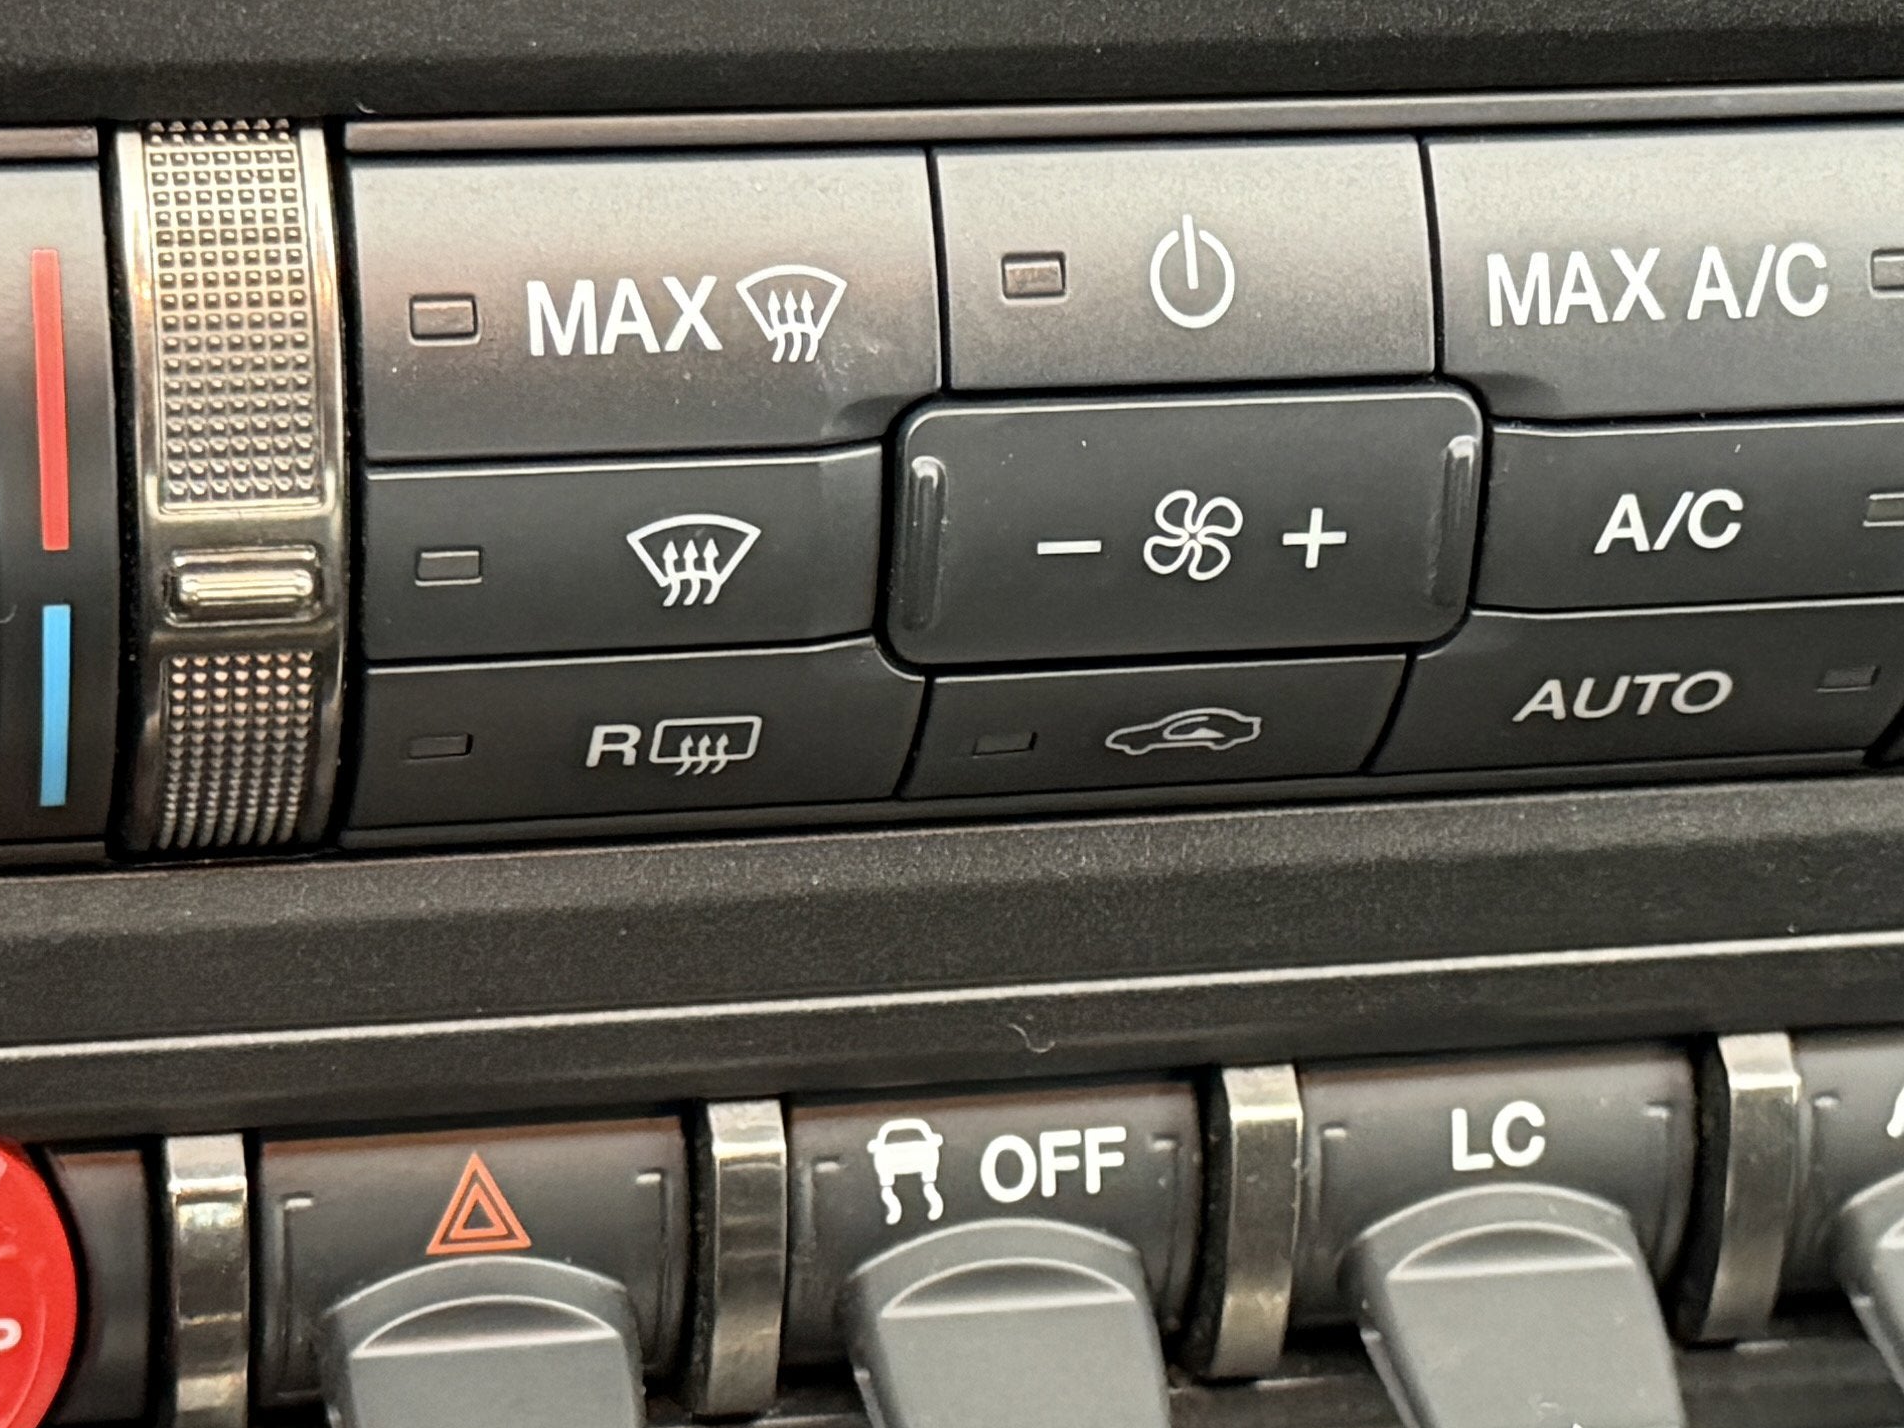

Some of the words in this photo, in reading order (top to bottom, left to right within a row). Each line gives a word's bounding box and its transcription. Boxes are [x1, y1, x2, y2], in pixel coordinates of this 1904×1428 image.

[524, 272, 725, 359] MAX
[1485, 244, 1667, 328] MAX
[1686, 241, 1832, 321] A/C
[1593, 486, 1745, 556] A/C
[1510, 668, 1734, 724] AUTO
[584, 721, 638, 769] R
[978, 1123, 1129, 1204] OFF
[1449, 1099, 1547, 1174] LC
